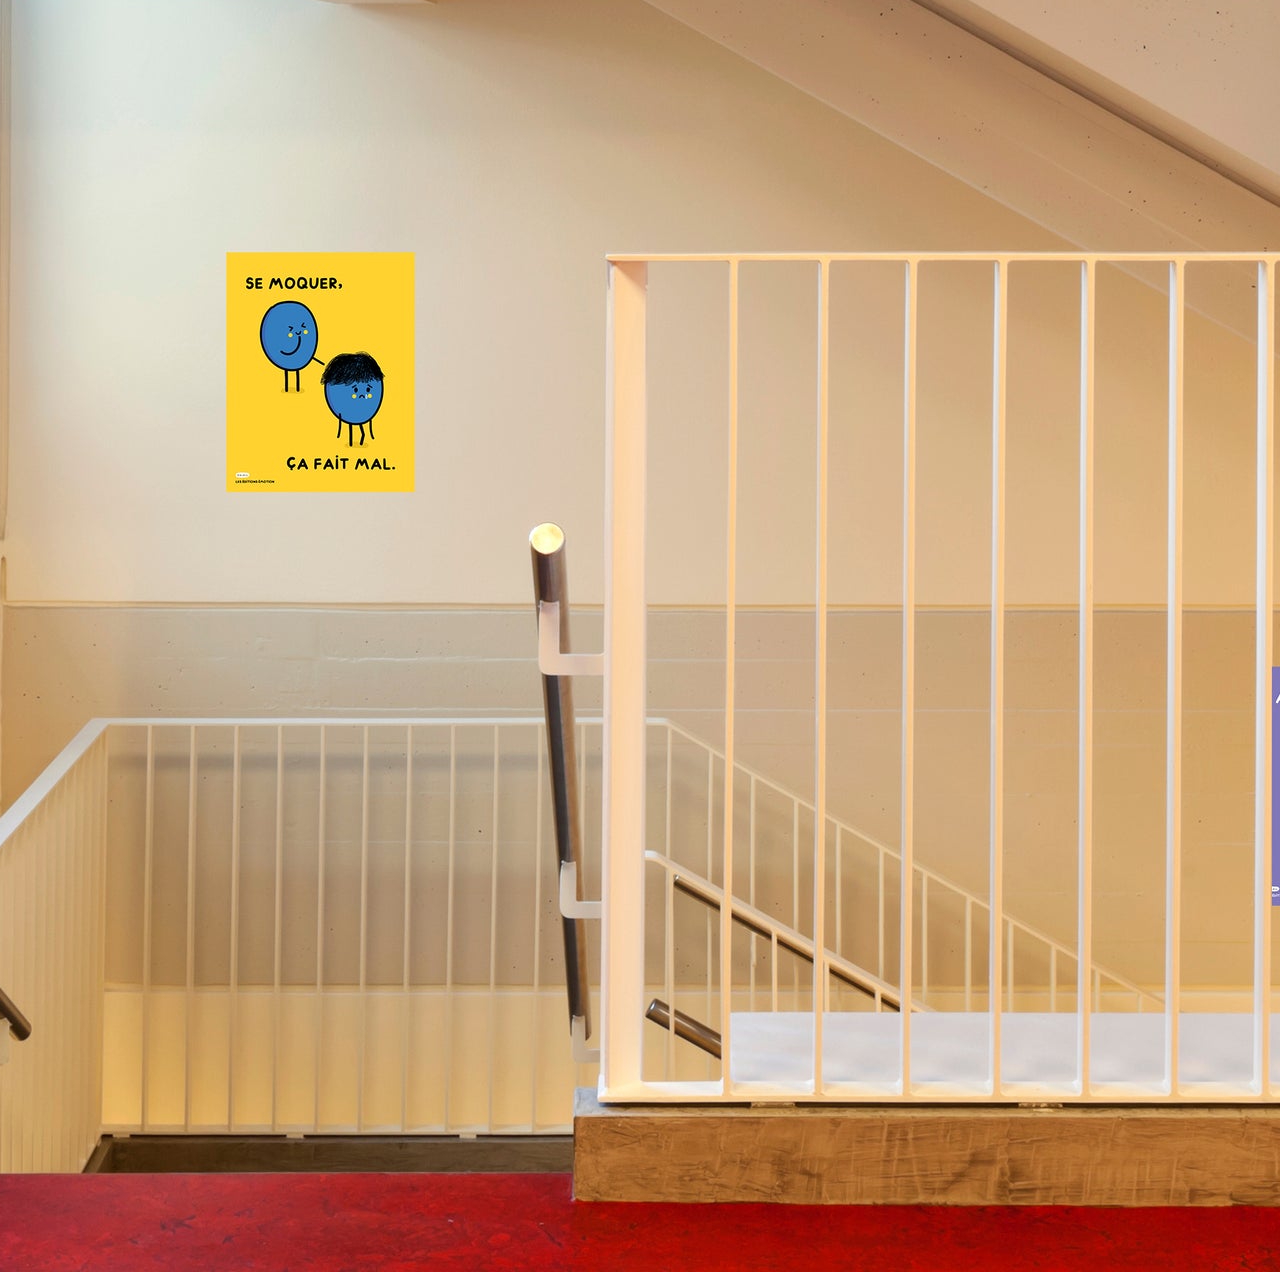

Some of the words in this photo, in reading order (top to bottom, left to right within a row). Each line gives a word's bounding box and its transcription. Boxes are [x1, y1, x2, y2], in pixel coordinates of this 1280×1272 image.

[245, 276, 264, 290] SE
[268, 276, 343, 290] MOQUER,
[286, 456, 309, 471] ÇA
[354, 457, 396, 471] MAL.
